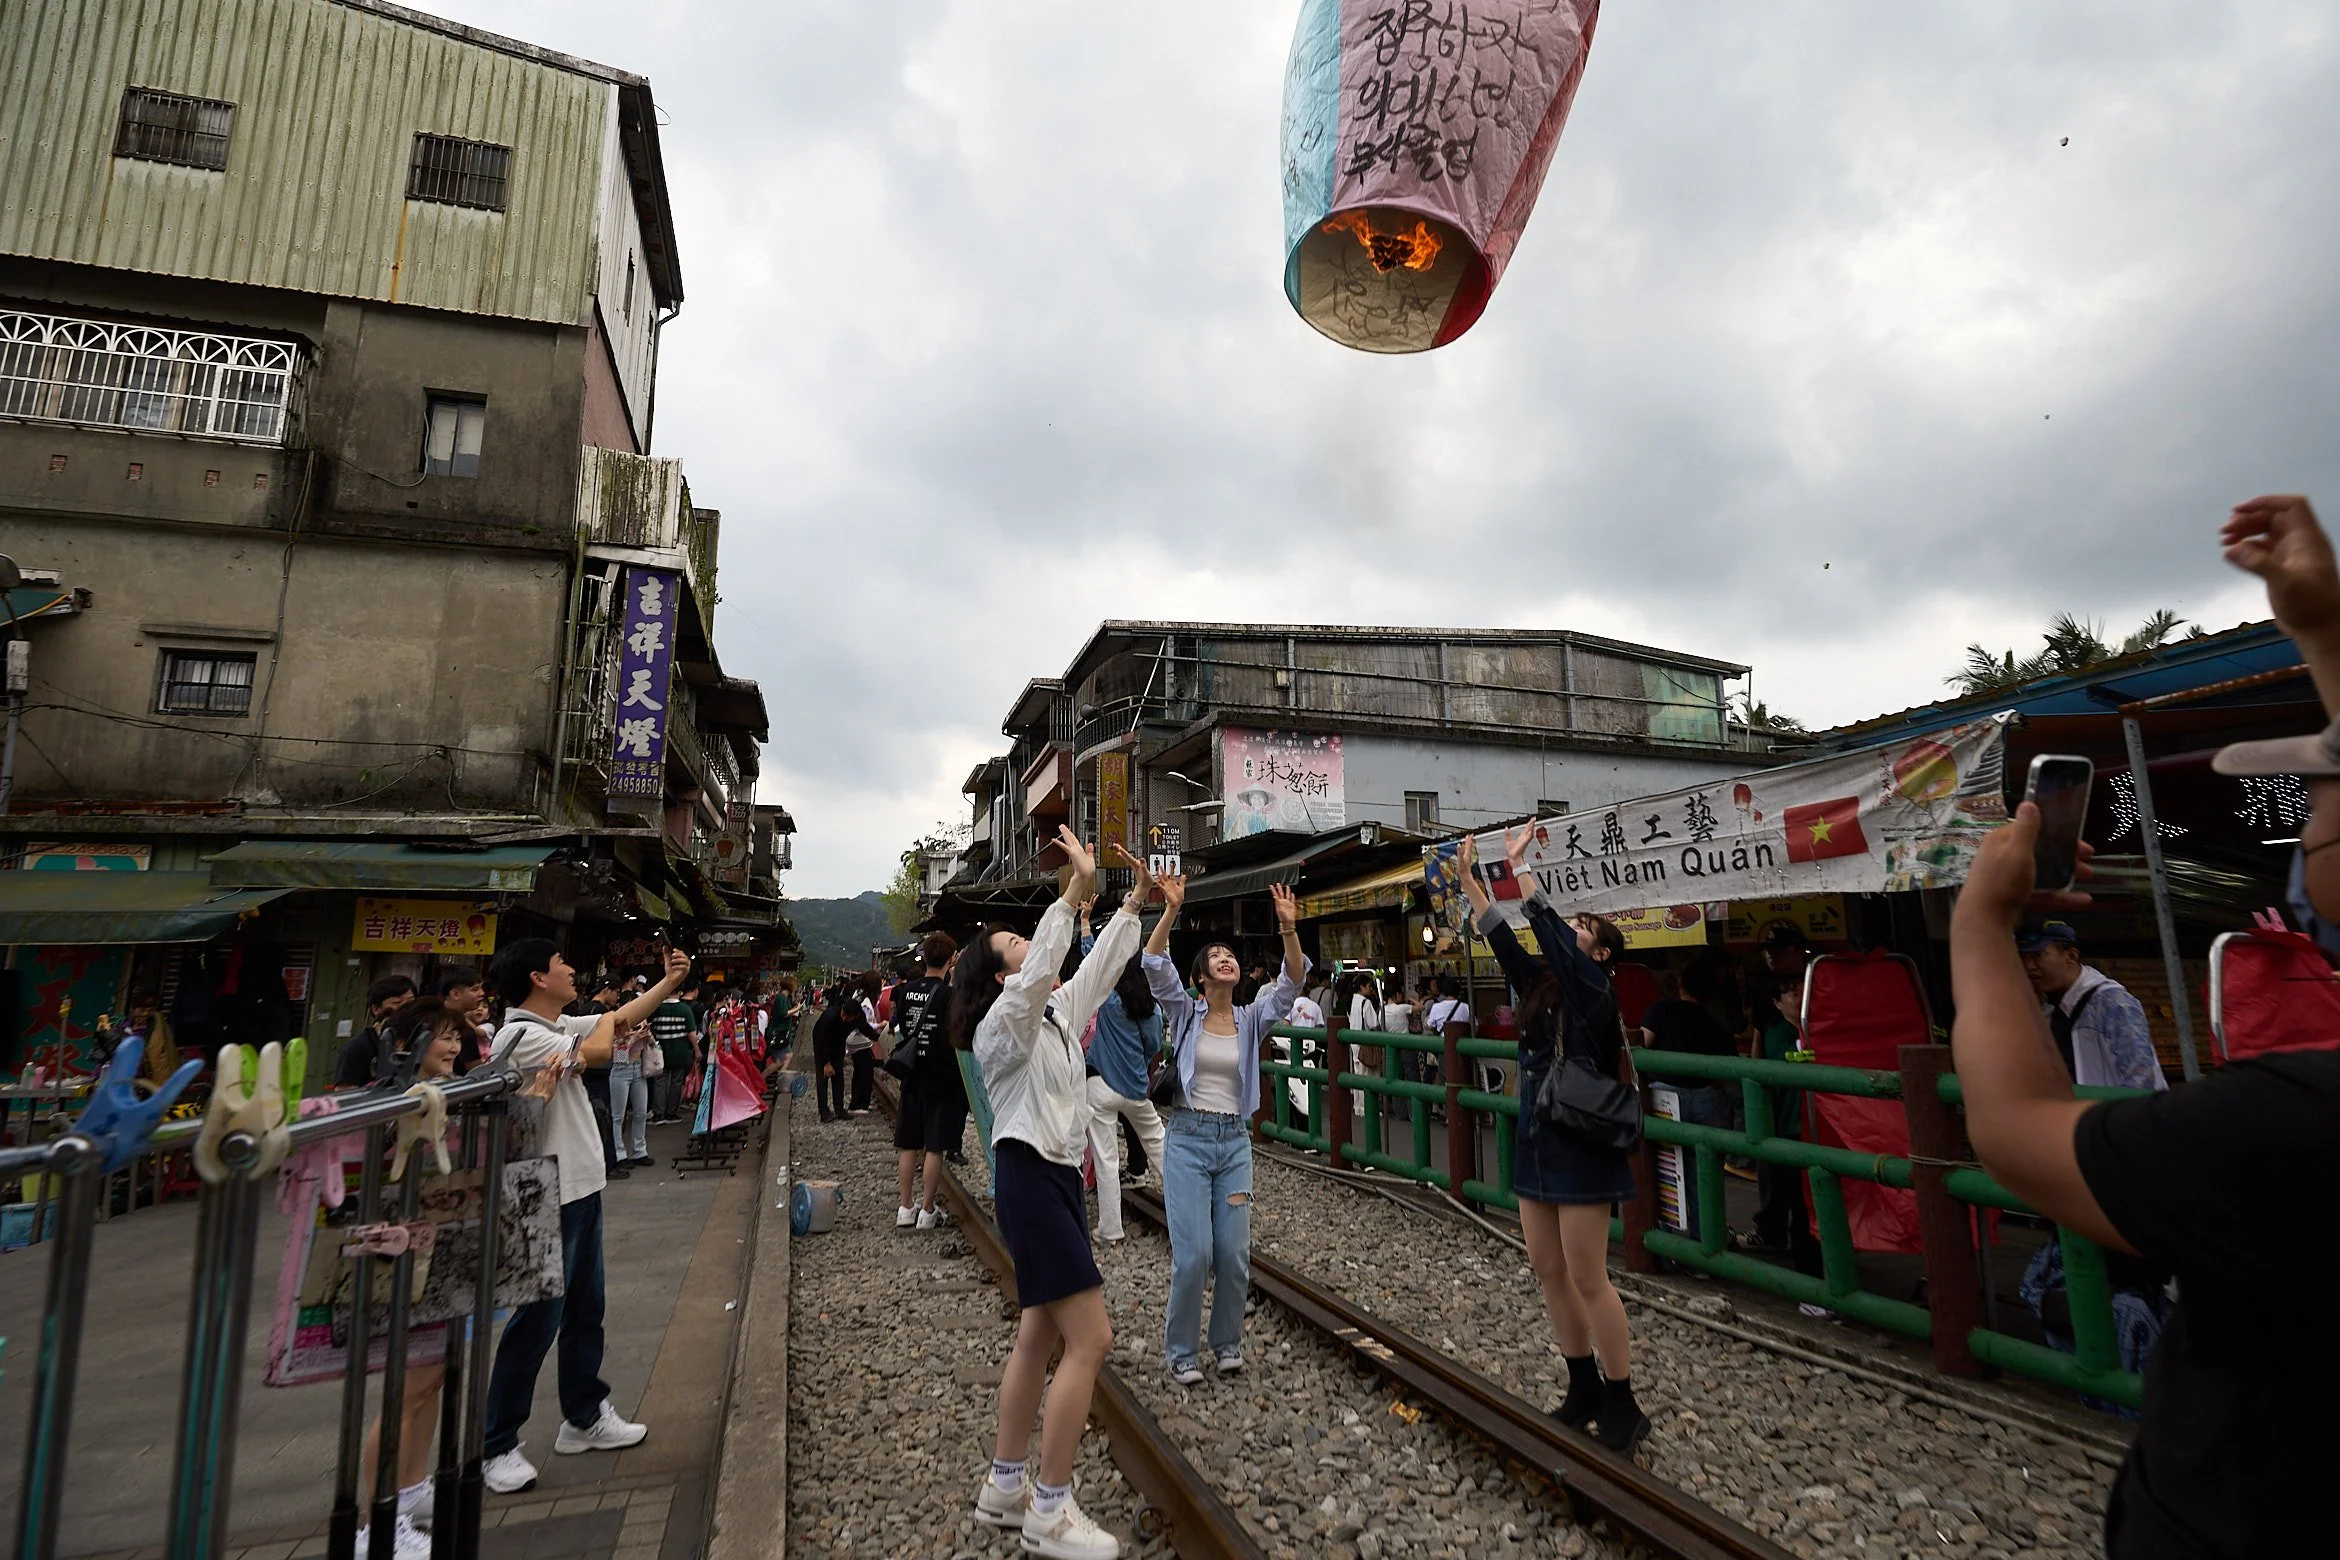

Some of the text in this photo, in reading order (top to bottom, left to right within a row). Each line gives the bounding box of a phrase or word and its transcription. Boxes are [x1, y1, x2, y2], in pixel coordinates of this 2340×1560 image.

[617, 576, 665, 757] 吉祥天燈
[610, 777, 659, 794] 24958850
[1565, 792, 1720, 860] 天鼎工藝
[1600, 858, 1666, 888] Nam
[1680, 841, 1774, 877] Quán
[363, 914, 461, 941] 吉祥天燈
